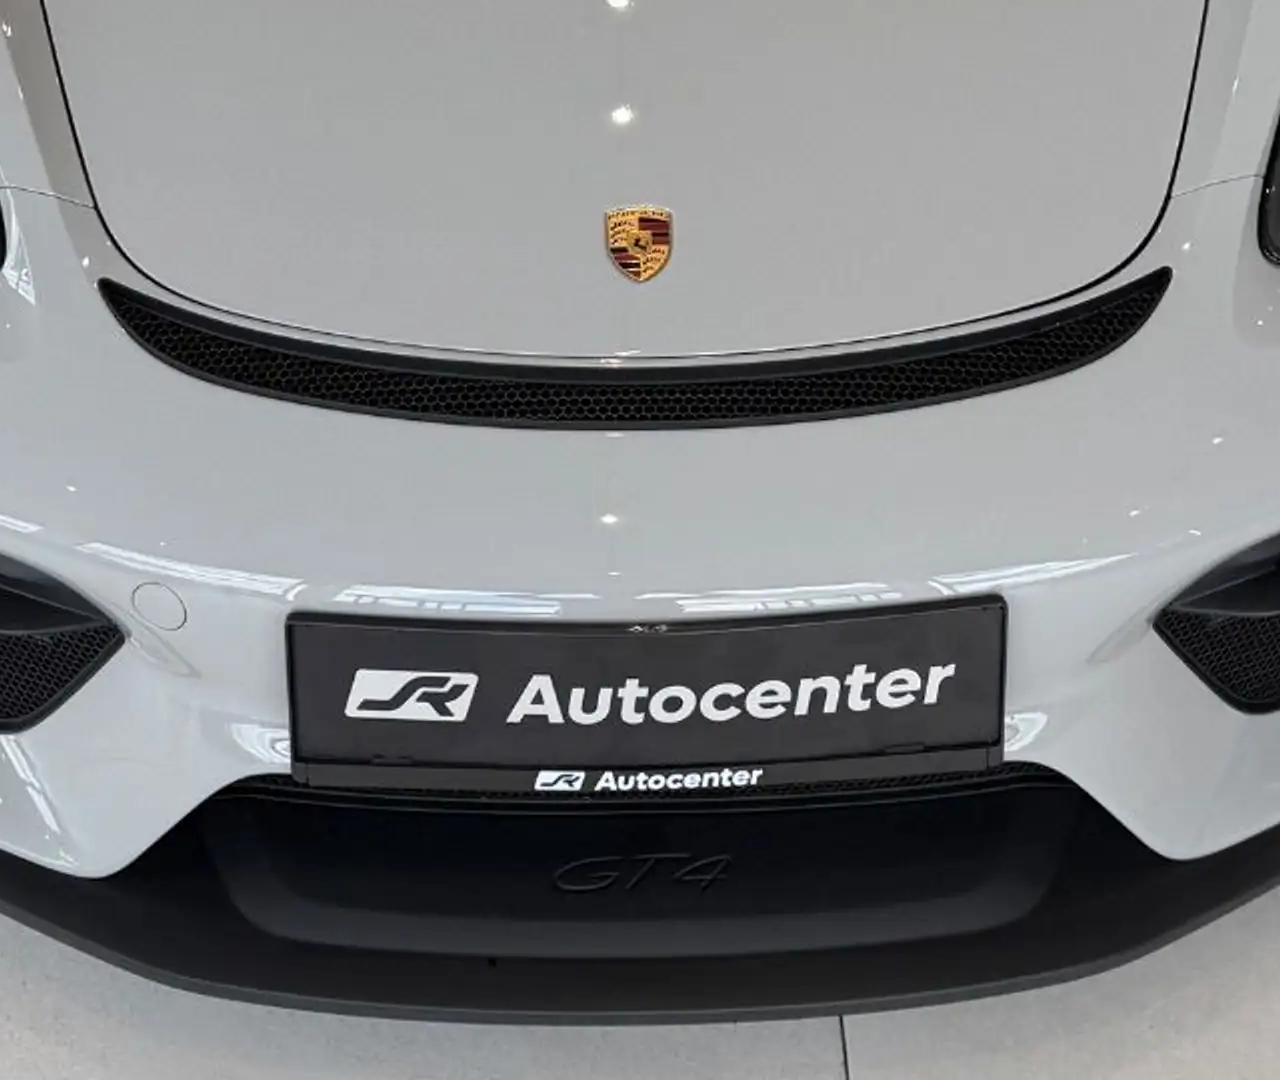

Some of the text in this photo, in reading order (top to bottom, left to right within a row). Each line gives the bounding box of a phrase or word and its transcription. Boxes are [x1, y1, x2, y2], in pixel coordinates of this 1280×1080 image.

[506, 663, 956, 725] Autocenter
[594, 767, 764, 792] Autocenter
[553, 852, 732, 892] GT4
